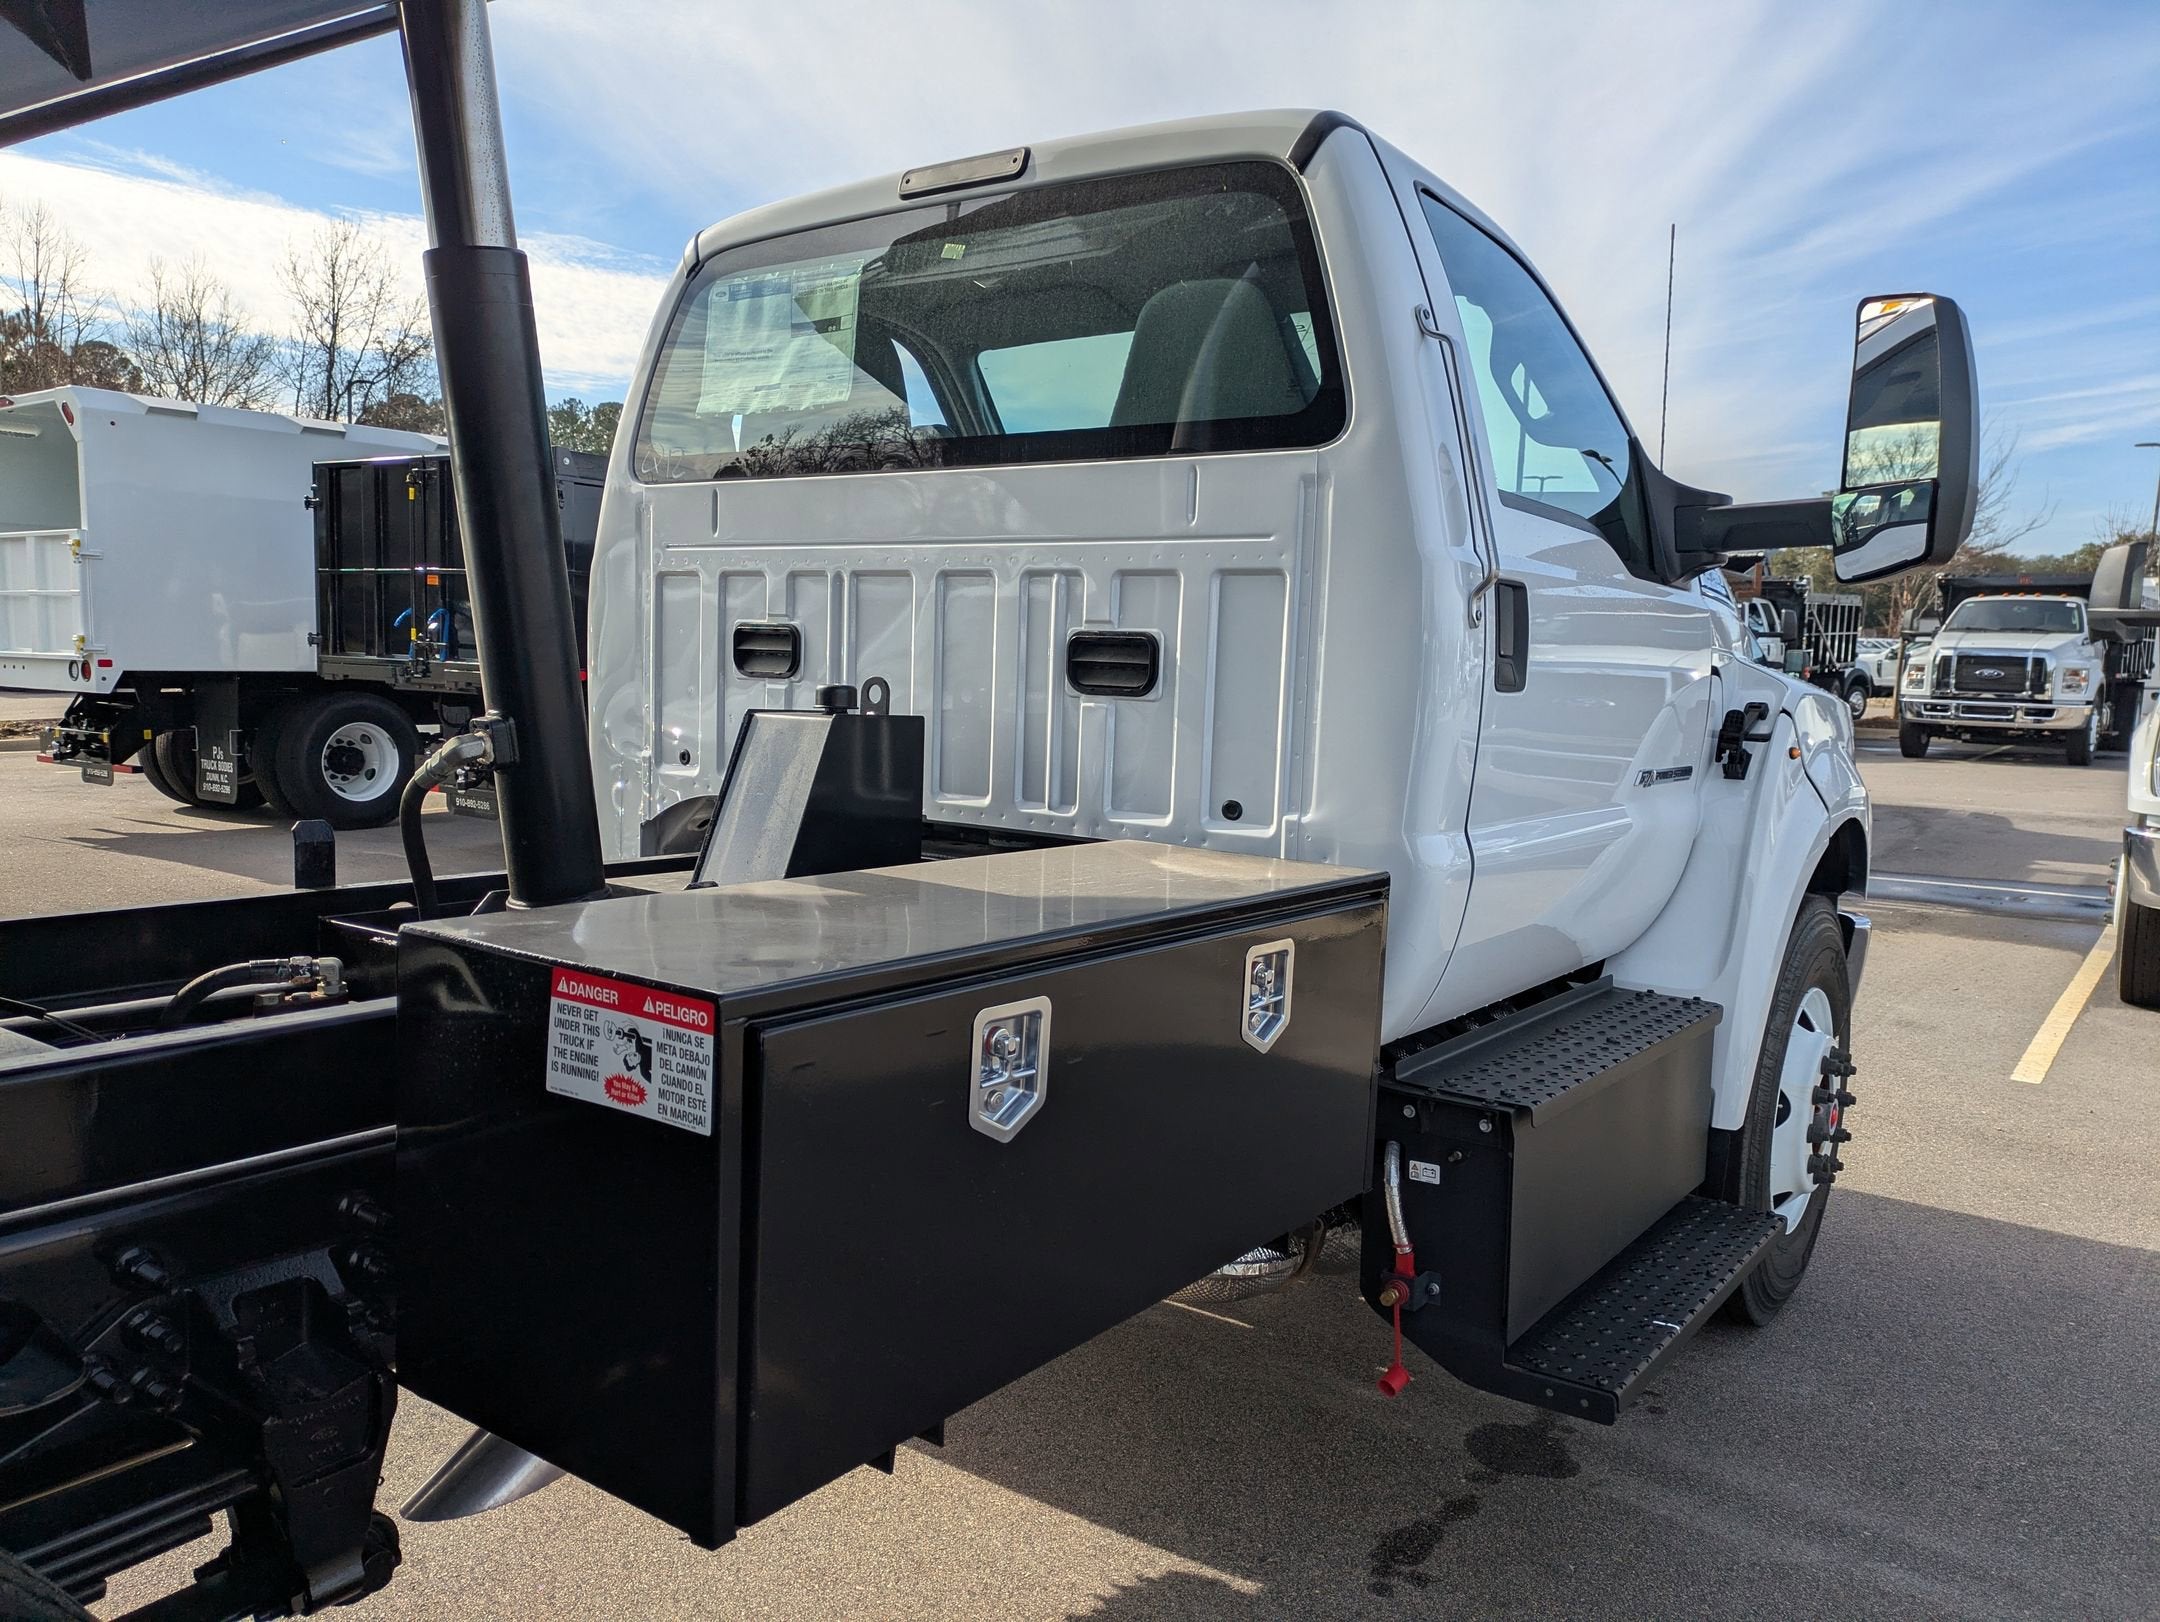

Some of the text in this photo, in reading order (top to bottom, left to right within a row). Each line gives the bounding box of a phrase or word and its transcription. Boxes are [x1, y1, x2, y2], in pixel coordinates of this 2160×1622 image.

[212, 746, 224, 759] PJs
[201, 759, 233, 773] TRUCK BODIES
[569, 981, 618, 1005] DANGER
[557, 1003, 599, 1022] NEVER GET
[656, 1002, 708, 1027] PELIGRO
[554, 1018, 600, 1037] UNDER THIS
[662, 1028, 704, 1049] ¡NUNCA SE
[559, 1033, 594, 1050] TRUCK IF
[553, 1046, 599, 1067] THE ENGINE
[657, 1042, 710, 1065] META DEBAJO
[551, 1060, 599, 1082] IS RUNNING!
[660, 1058, 707, 1081] DEL CAMIÓN
[661, 1073, 704, 1096] CUANDO EL
[658, 1088, 706, 1112] MOTOR ESTÉ
[658, 1104, 668, 1116] EN
[670, 1107, 706, 1128] MARCHA!
